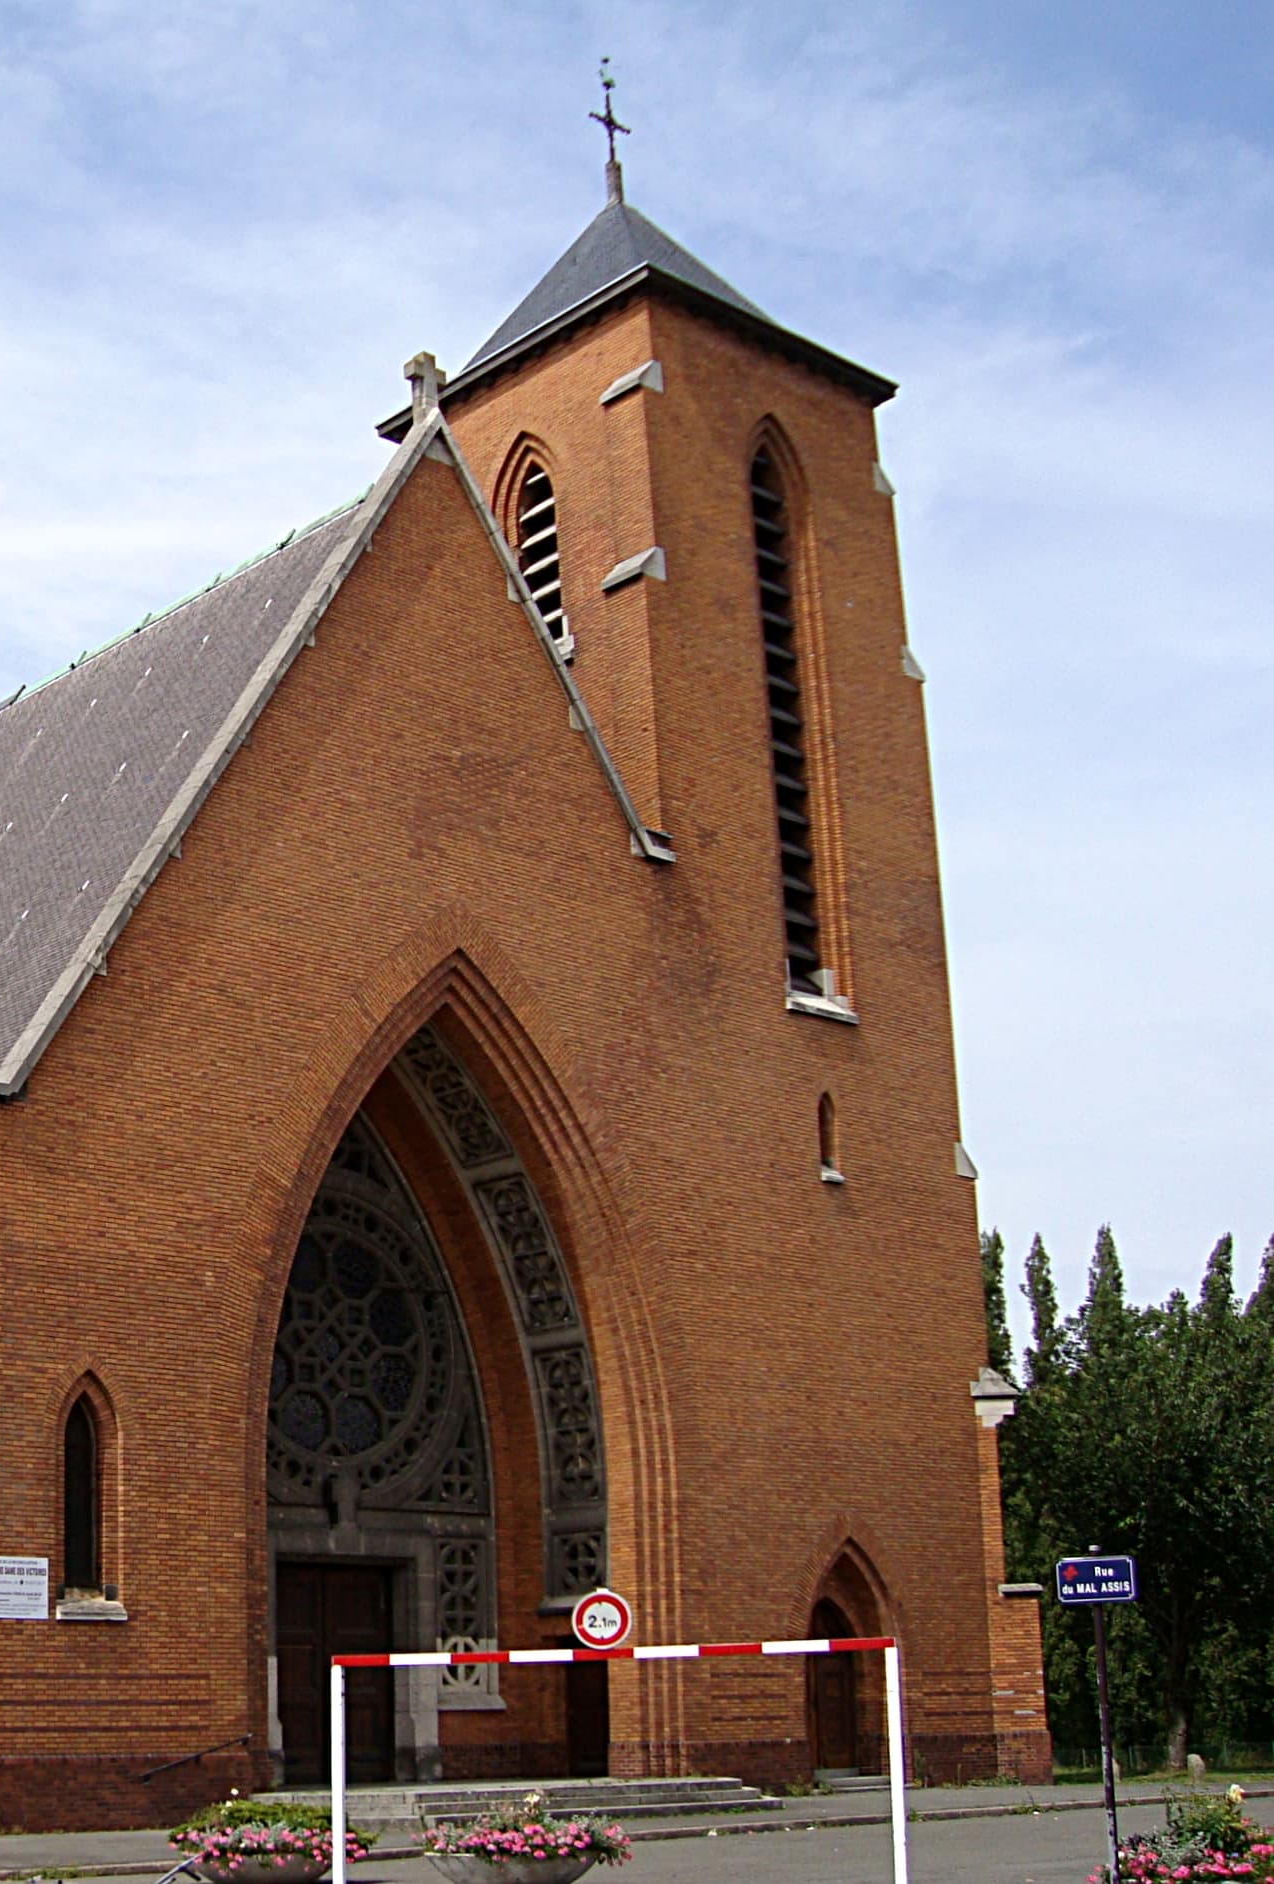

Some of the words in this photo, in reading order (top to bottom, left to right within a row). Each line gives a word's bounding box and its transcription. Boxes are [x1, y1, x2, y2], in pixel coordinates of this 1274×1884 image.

[1094, 1566, 1114, 1576] Rue
[1062, 1584, 1073, 1594] du
[1076, 1583, 1097, 1593] MAL
[1101, 1581, 1130, 1593] ASSIS
[588, 1615, 617, 1628] 2.1m
